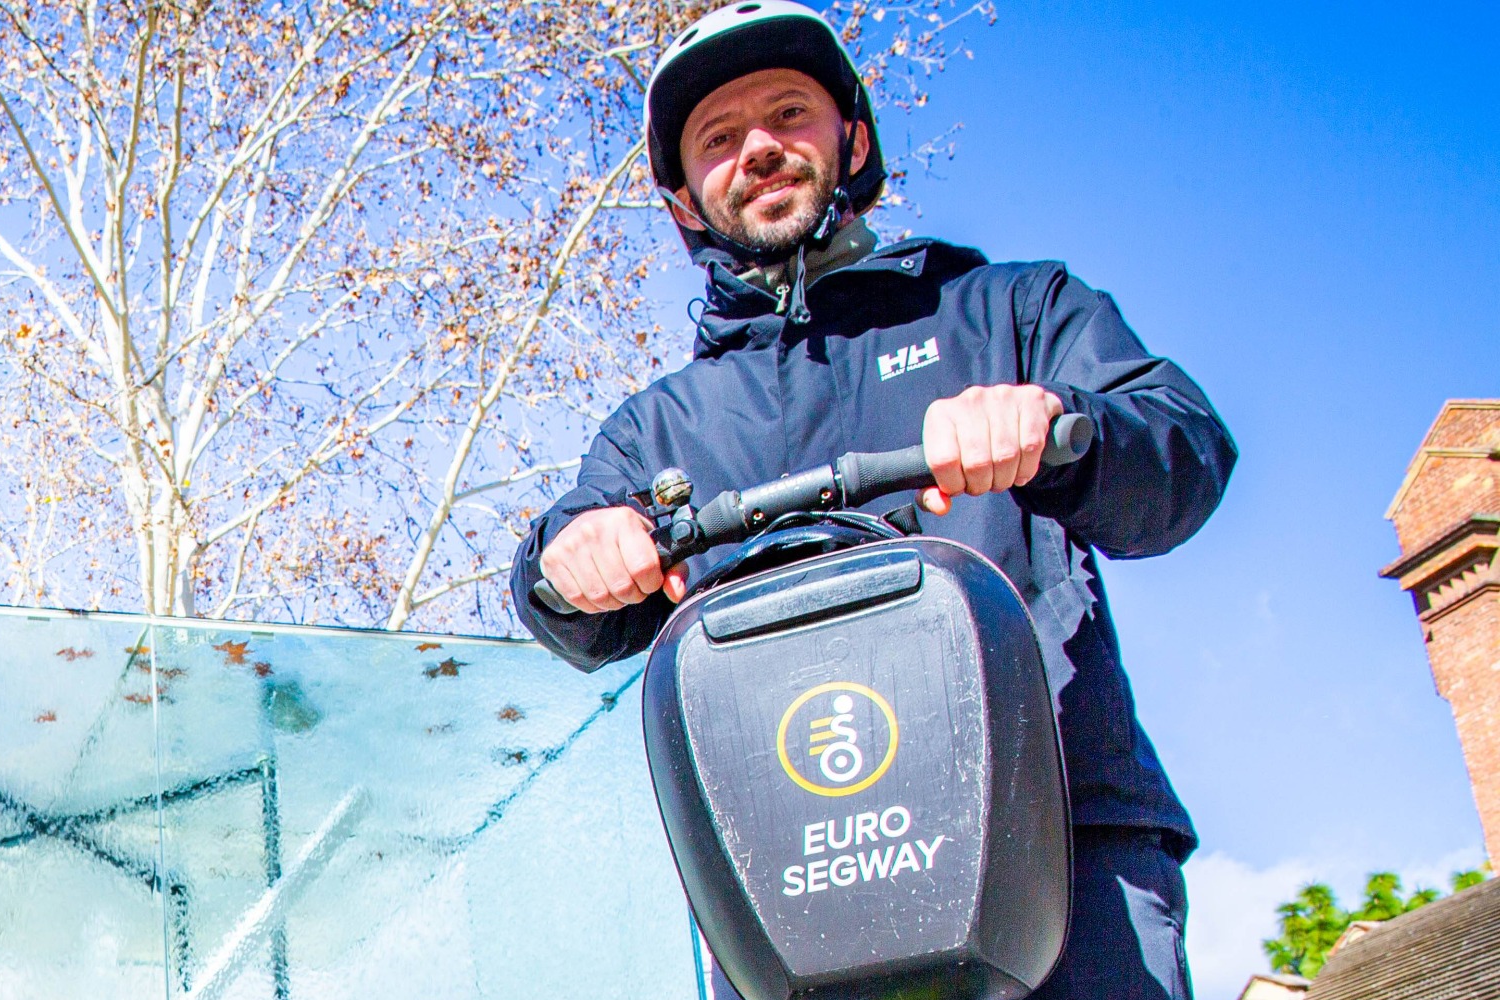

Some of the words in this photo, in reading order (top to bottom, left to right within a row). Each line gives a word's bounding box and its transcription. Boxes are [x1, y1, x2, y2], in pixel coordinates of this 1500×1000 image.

[878, 337, 939, 376] HH
[804, 806, 911, 855] EURO
[782, 835, 946, 897] SEGWAY
